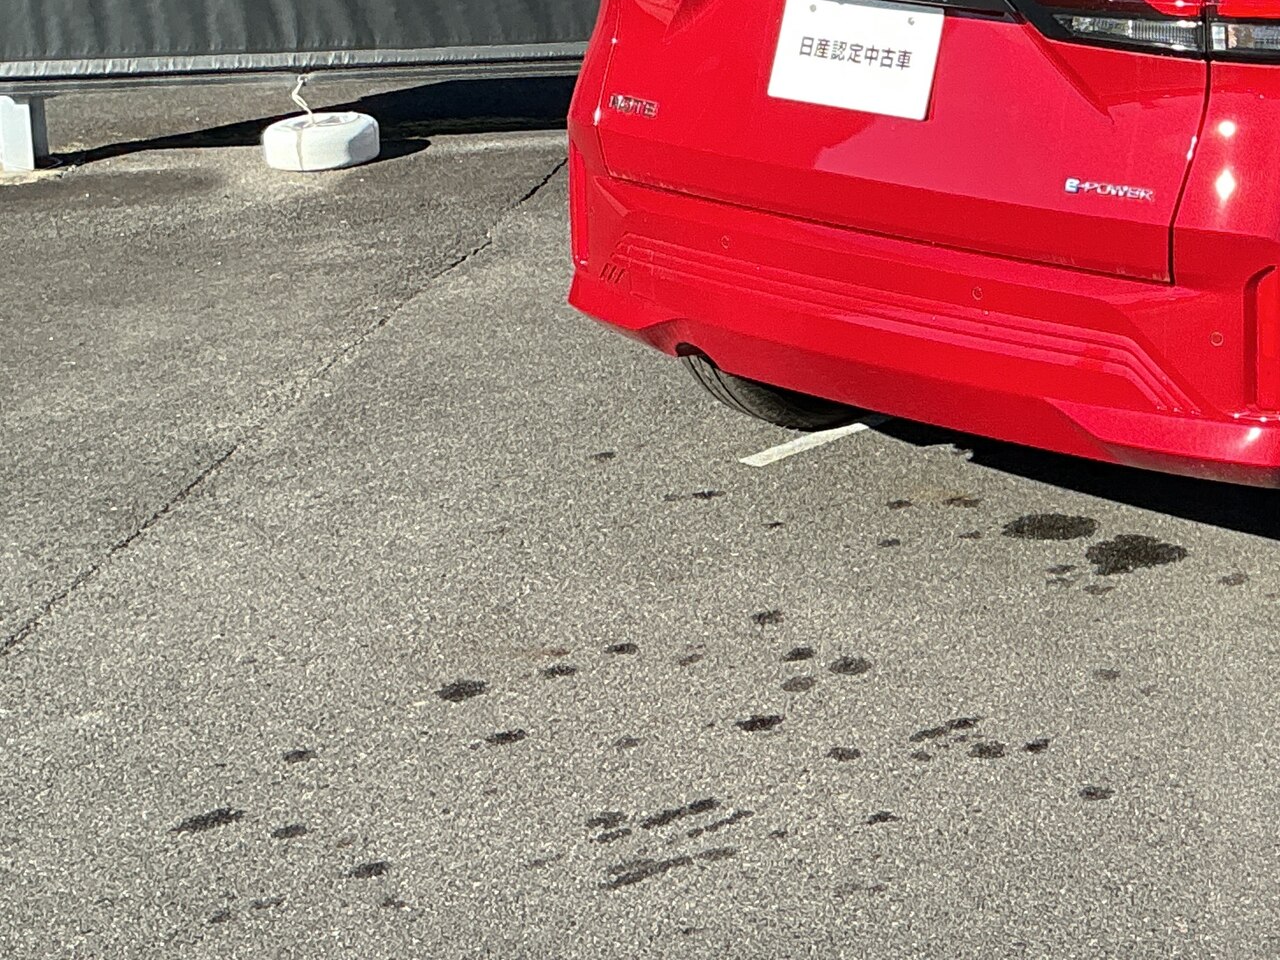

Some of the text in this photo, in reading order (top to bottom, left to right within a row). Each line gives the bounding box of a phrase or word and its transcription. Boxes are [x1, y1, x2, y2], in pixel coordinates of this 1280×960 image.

[799, 36, 913, 70] 日産認定中古車
